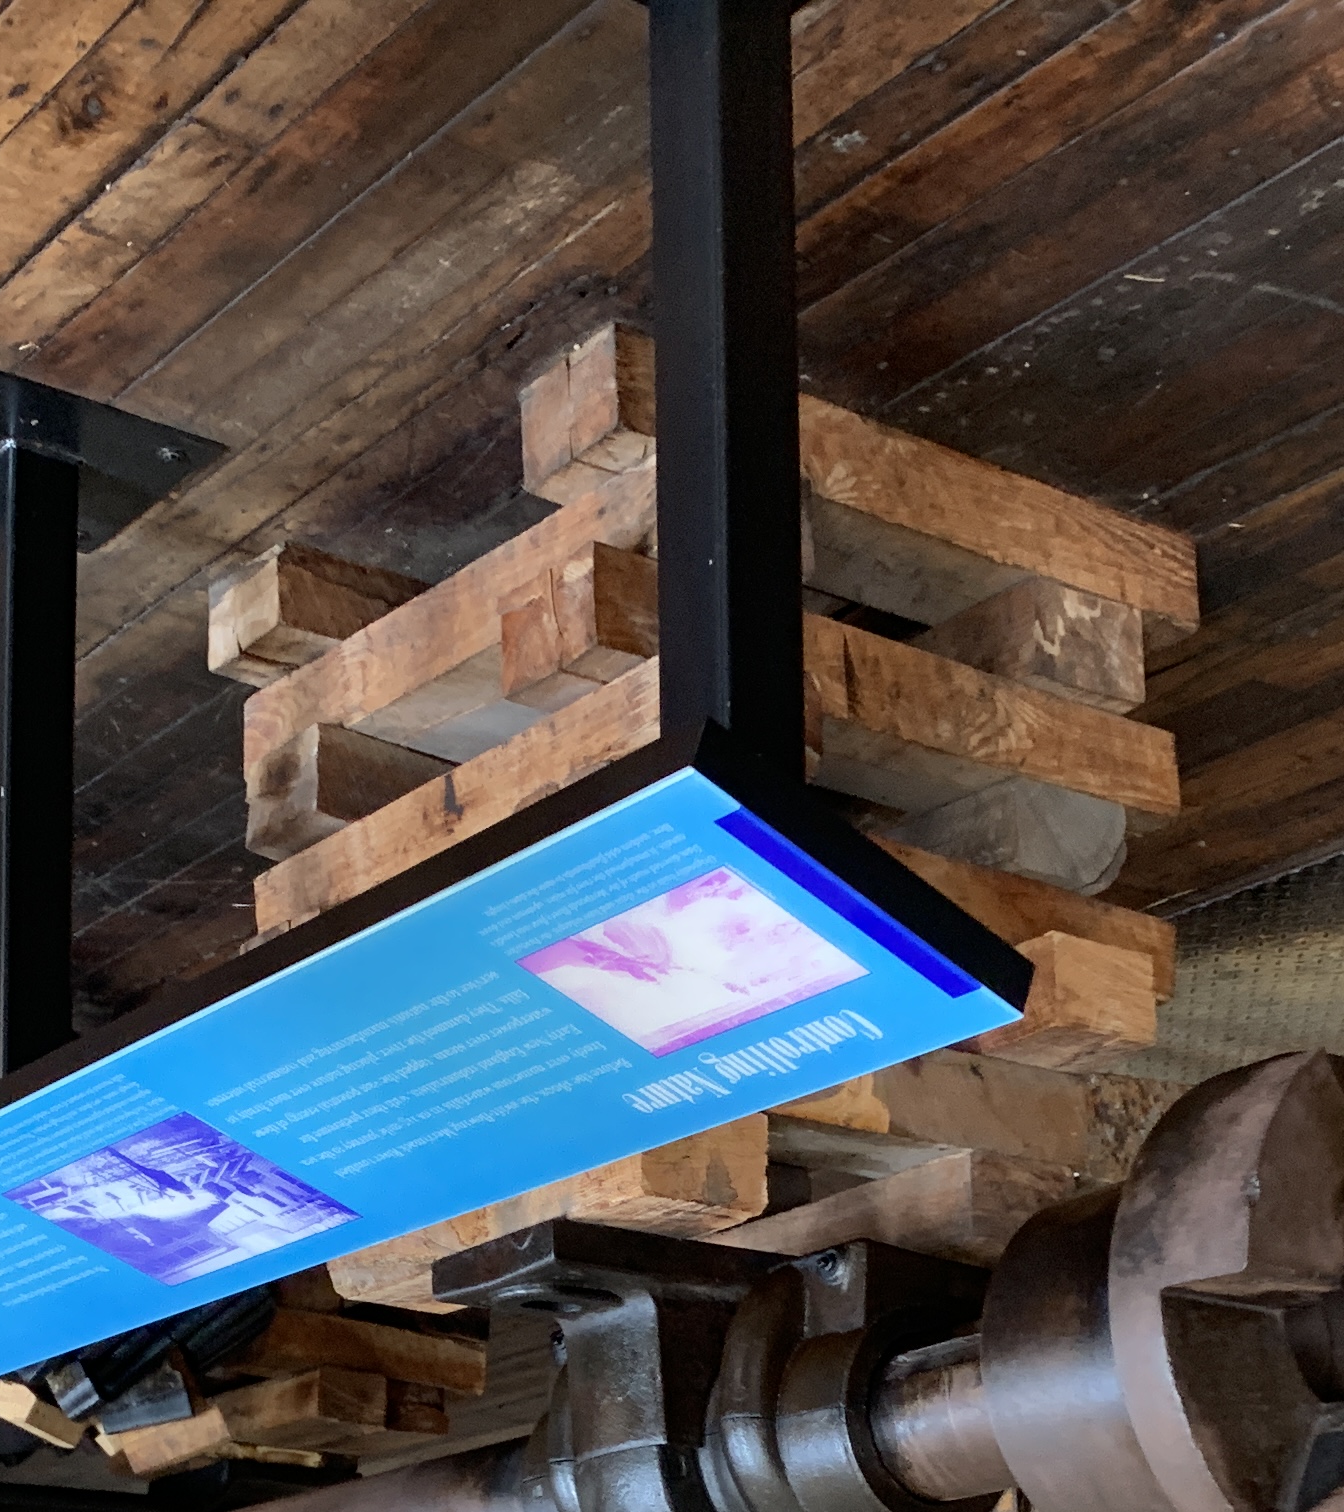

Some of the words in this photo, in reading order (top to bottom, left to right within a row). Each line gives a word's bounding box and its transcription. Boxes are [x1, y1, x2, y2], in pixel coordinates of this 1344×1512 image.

[459, 970, 499, 994] service
[428, 994, 451, 1007] the
[468, 1001, 503, 1018] They
[421, 1013, 472, 1040] dammed
[489, 1007, 551, 1038] waterpower
[310, 1020, 390, 1058] manufacturing
[405, 1033, 428, 1047] the
[465, 1032, 492, 1049] over
[547, 1023, 583, 1041] Early
[522, 1038, 553, 1051] New
[567, 1040, 607, 1059] freely
[699, 1009, 884, 1083] Controlling
[295, 1052, 318, 1069] and
[336, 1050, 381, 1075] placing
[476, 1046, 528, 1071] England
[544, 1054, 572, 1070] over
[589, 1057, 633, 1077] Before
[308, 1068, 345, 1088] nature
[394, 1058, 434, 1080] tapped
[491, 1064, 547, 1090] numerous
[378, 1072, 401, 1085] the
[573, 1072, 595, 1085] the
[288, 1083, 313, 1098] ever
[316, 1086, 363, 1111] potential
[441, 1086, 493, 1111] waterfalls
[622, 1066, 731, 1114] Nature
[264, 1091, 293, 1108] more
[383, 1094, 411, 1109] with
[519, 1094, 541, 1106] the
[234, 1102, 273, 1120] firmly
[252, 1123, 282, 1139] these
[274, 1118, 290, 1132] of
[297, 1132, 320, 1145] for
[341, 1128, 381, 1150] journey
[397, 1126, 459, 1153] Merrimack
[314, 1149, 338, 1161] the
[373, 1147, 406, 1163] River
